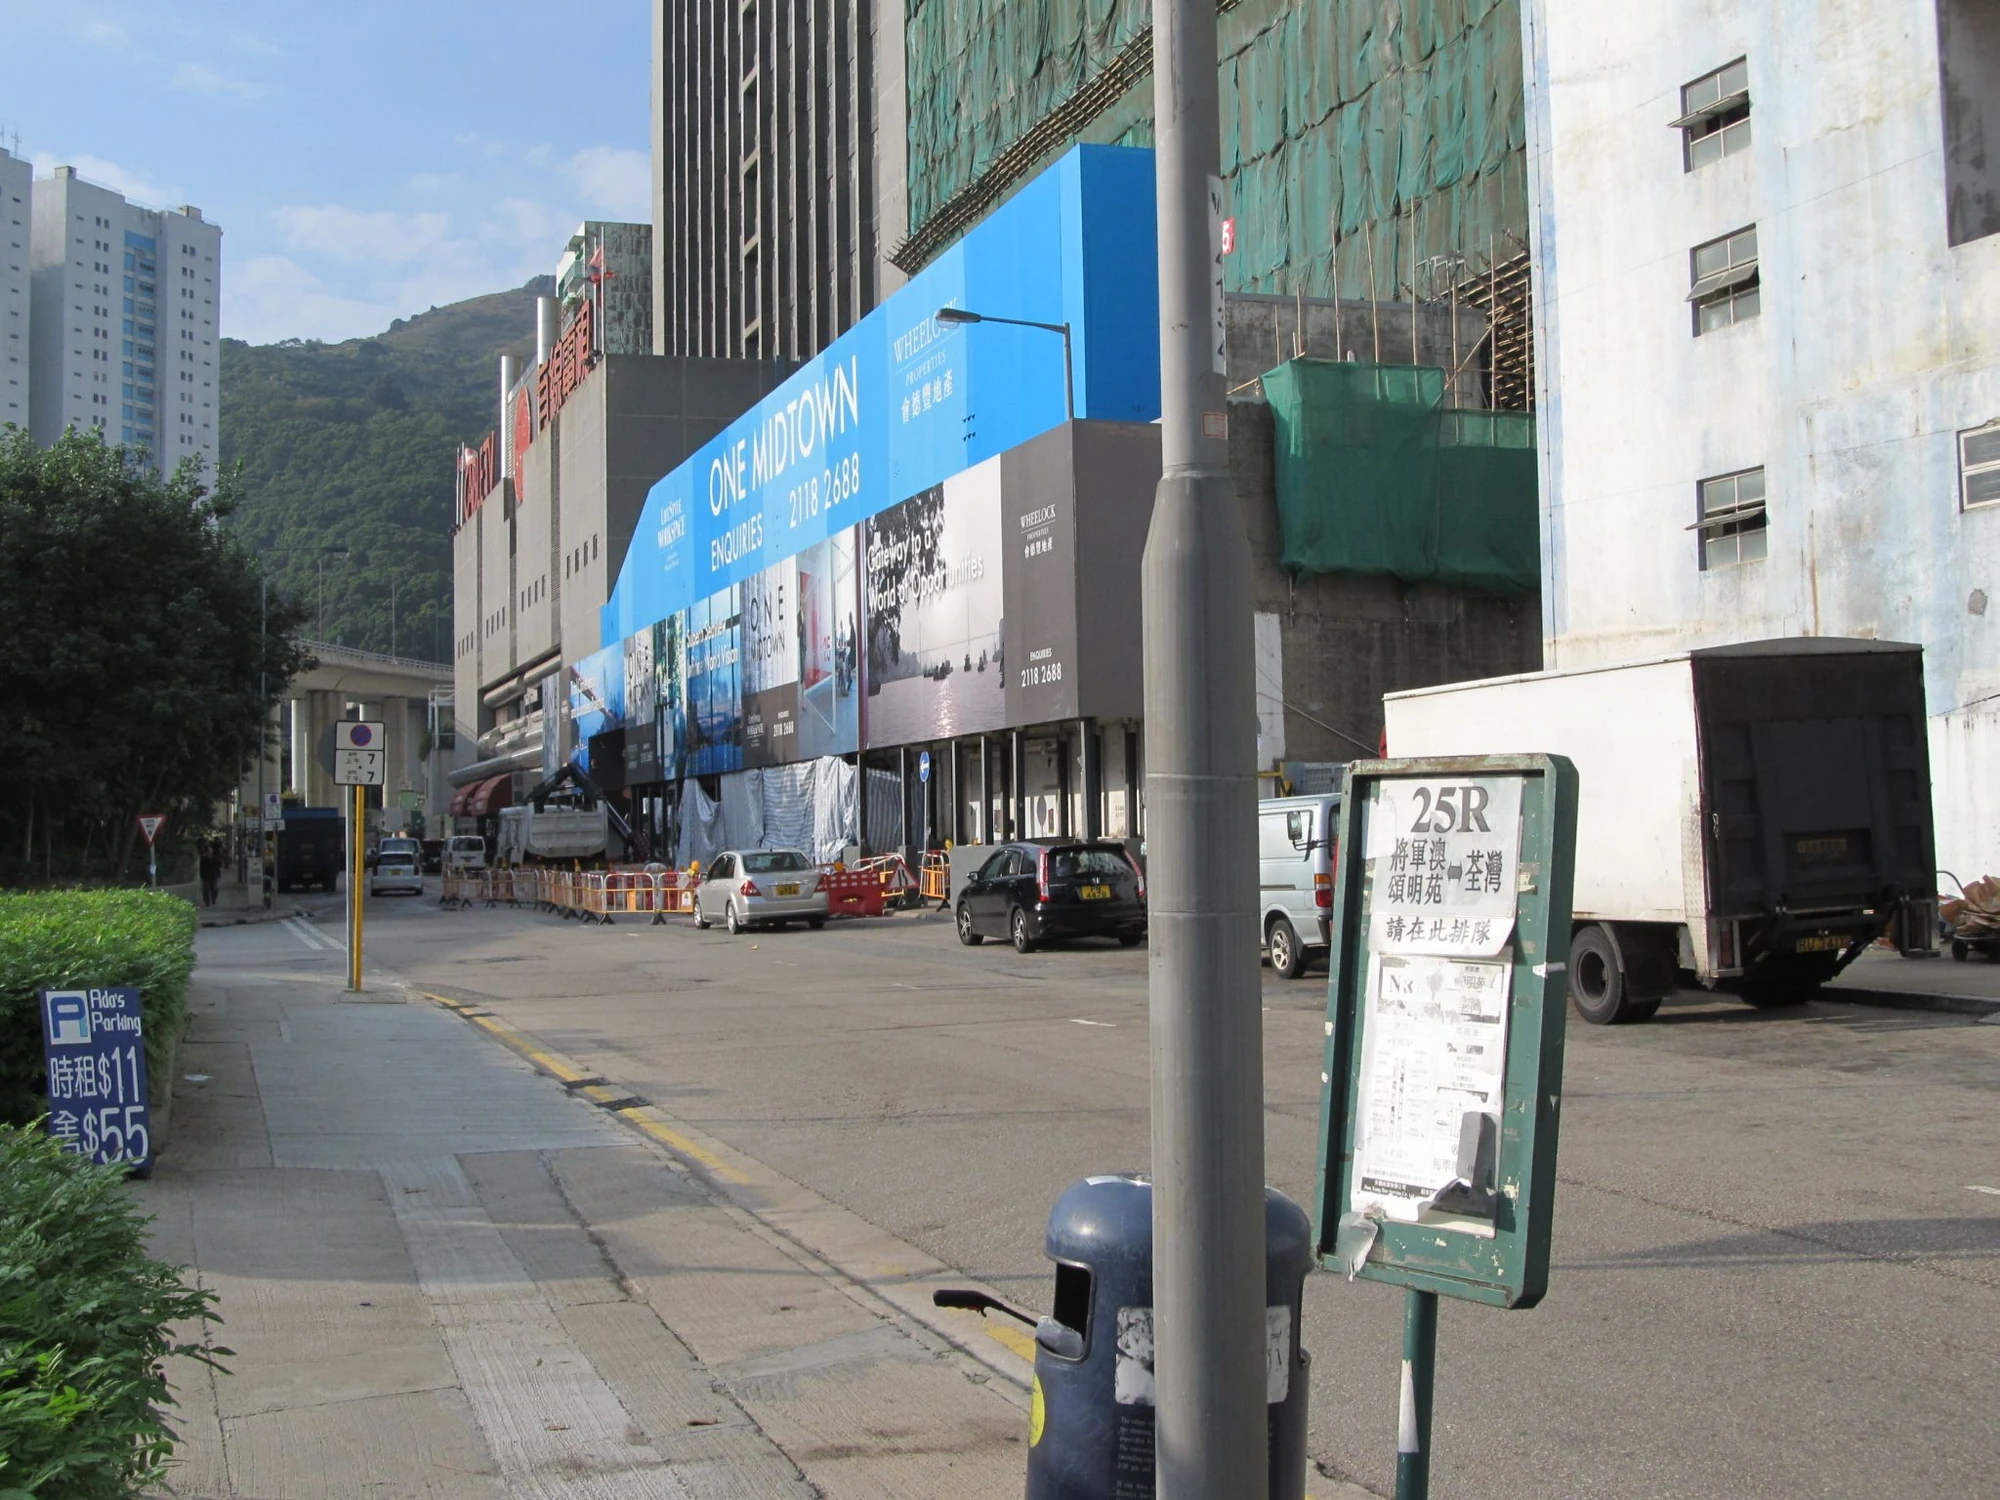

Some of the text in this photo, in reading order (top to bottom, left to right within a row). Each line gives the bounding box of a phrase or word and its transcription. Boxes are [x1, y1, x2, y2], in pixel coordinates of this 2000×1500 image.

[905, 350, 946, 387] PROPERTIES
[709, 355, 858, 517] ONE MIDTOWN
[789, 452, 860, 529] 2118 2688
[1019, 502, 1056, 530] WHEELOCK
[711, 511, 763, 572] ENQUIRIES
[867, 530, 932, 573] Gateway to a
[867, 551, 984, 613] World of Opportunities
[750, 585, 784, 632] ONE
[1029, 647, 1053, 662] ENQUIRIES
[1020, 662, 1063, 688] 2118 2688
[367, 771, 375, 783] 7
[368, 753, 375, 765] 7
[1410, 785, 1491, 834] 25R
[1389, 837, 1446, 872] 將軍澳
[1464, 849, 1503, 894] 荃灣
[1388, 872, 1442, 905] 頌明苑
[1386, 917, 1491, 946] 請在此排隊
[90, 989, 125, 1009] Ada's
[92, 1011, 142, 1037] Parking
[50, 1045, 140, 1103] 時租 $11
[82, 1105, 149, 1165] $55
